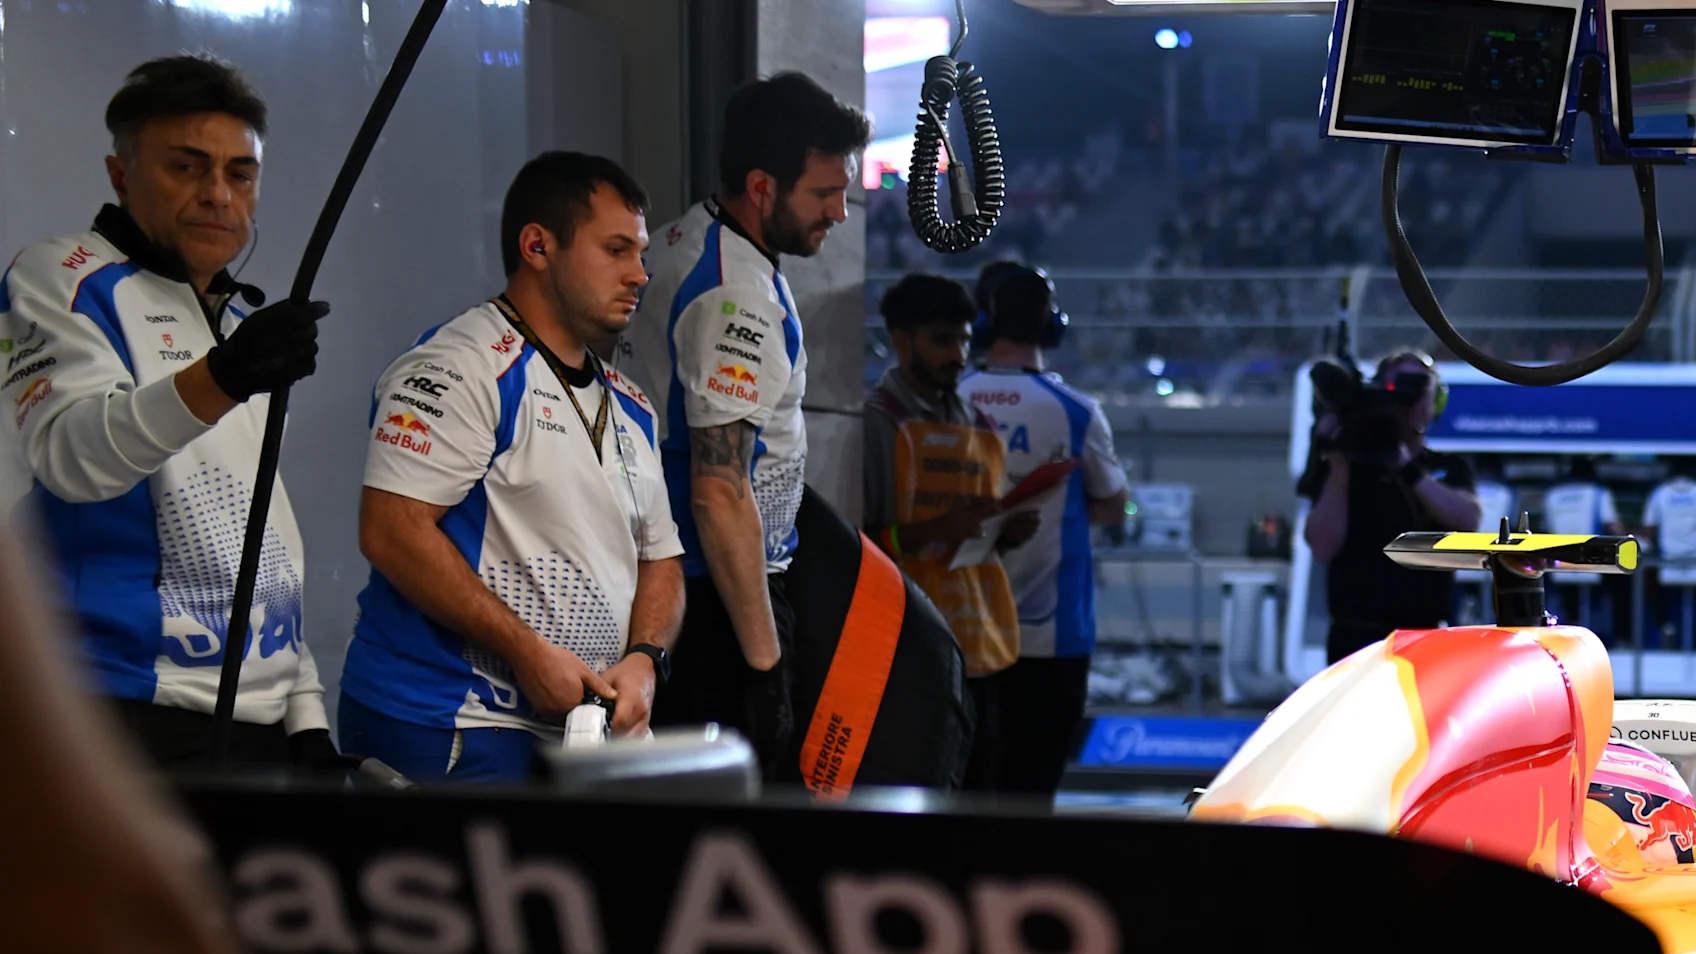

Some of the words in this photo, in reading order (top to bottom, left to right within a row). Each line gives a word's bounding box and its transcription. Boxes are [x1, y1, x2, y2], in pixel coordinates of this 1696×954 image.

[62, 246, 98, 270] HUG
[725, 322, 764, 346] HRC
[159, 350, 194, 361] TUDOR
[423, 361, 444, 374] Cash
[445, 369, 464, 383] App
[402, 375, 450, 398] HRC
[706, 378, 734, 397] Red
[735, 385, 760, 405] Bull
[374, 427, 400, 445] Red
[400, 433, 432, 455] Bull
[822, 726, 853, 795] SINISTRA
